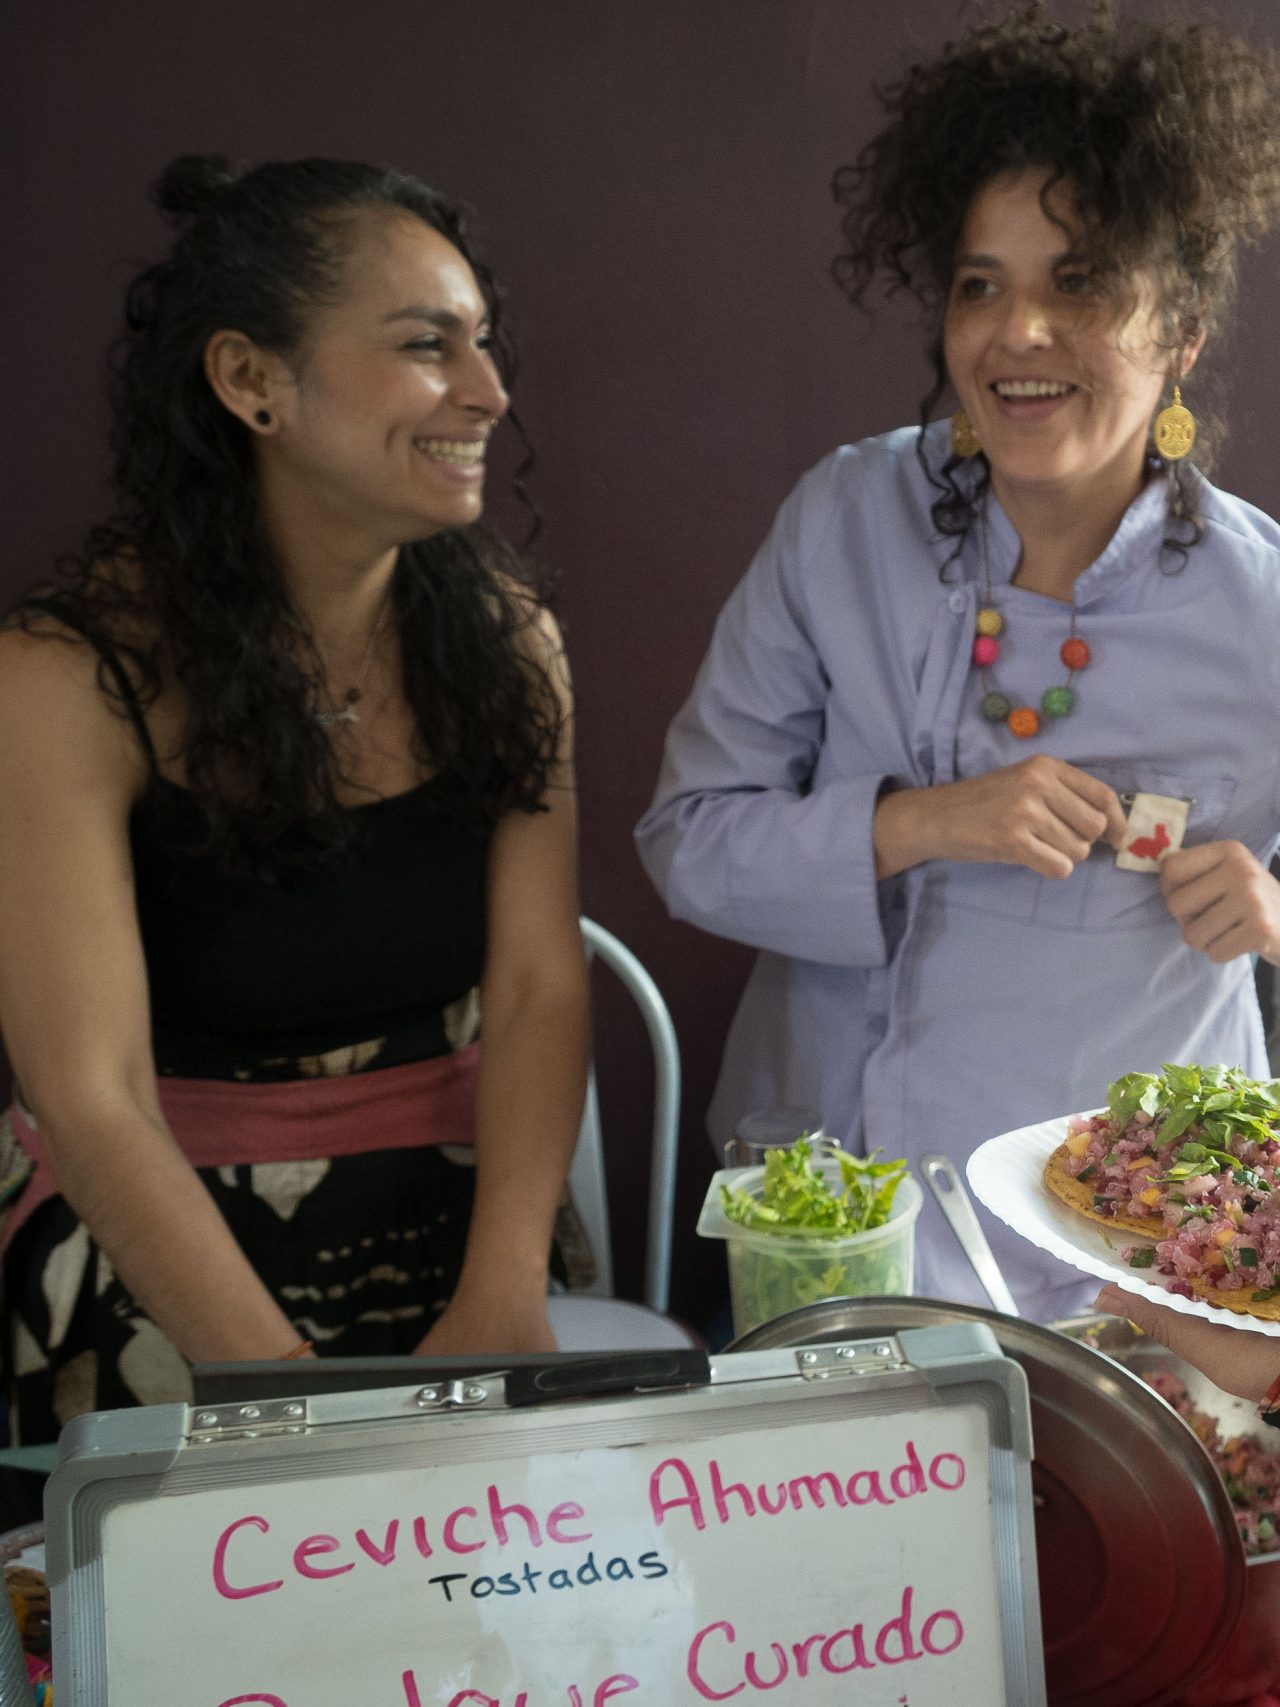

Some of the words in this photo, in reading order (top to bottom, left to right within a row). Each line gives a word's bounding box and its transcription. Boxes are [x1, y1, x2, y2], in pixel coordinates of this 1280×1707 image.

[212, 1484, 591, 1601] Ceviche
[648, 1440, 966, 1531] Ahumado
[427, 1549, 670, 1602] Tostadas
[686, 1585, 965, 1702] Curado
